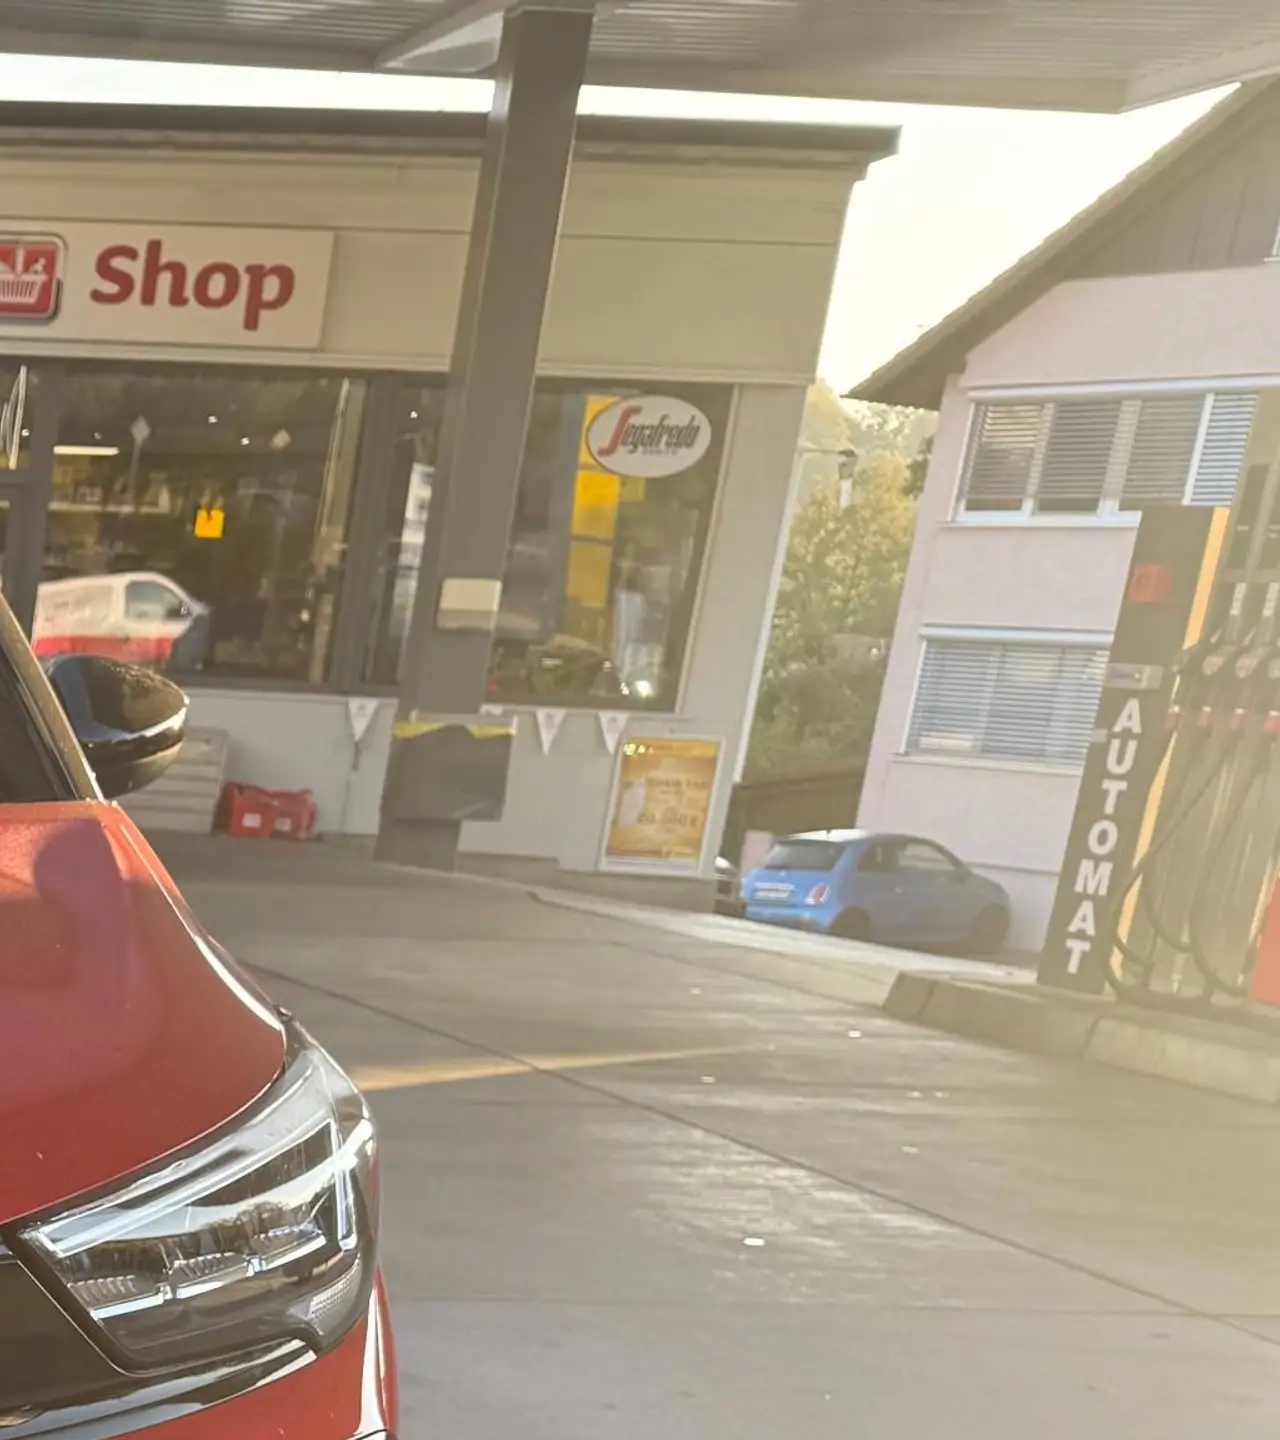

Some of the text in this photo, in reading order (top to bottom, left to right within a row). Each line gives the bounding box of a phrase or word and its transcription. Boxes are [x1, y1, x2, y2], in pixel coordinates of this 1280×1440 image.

[89, 238, 296, 332] Shop
[596, 403, 700, 457] Segafredo
[1066, 697, 1142, 975] AUTOMAT
